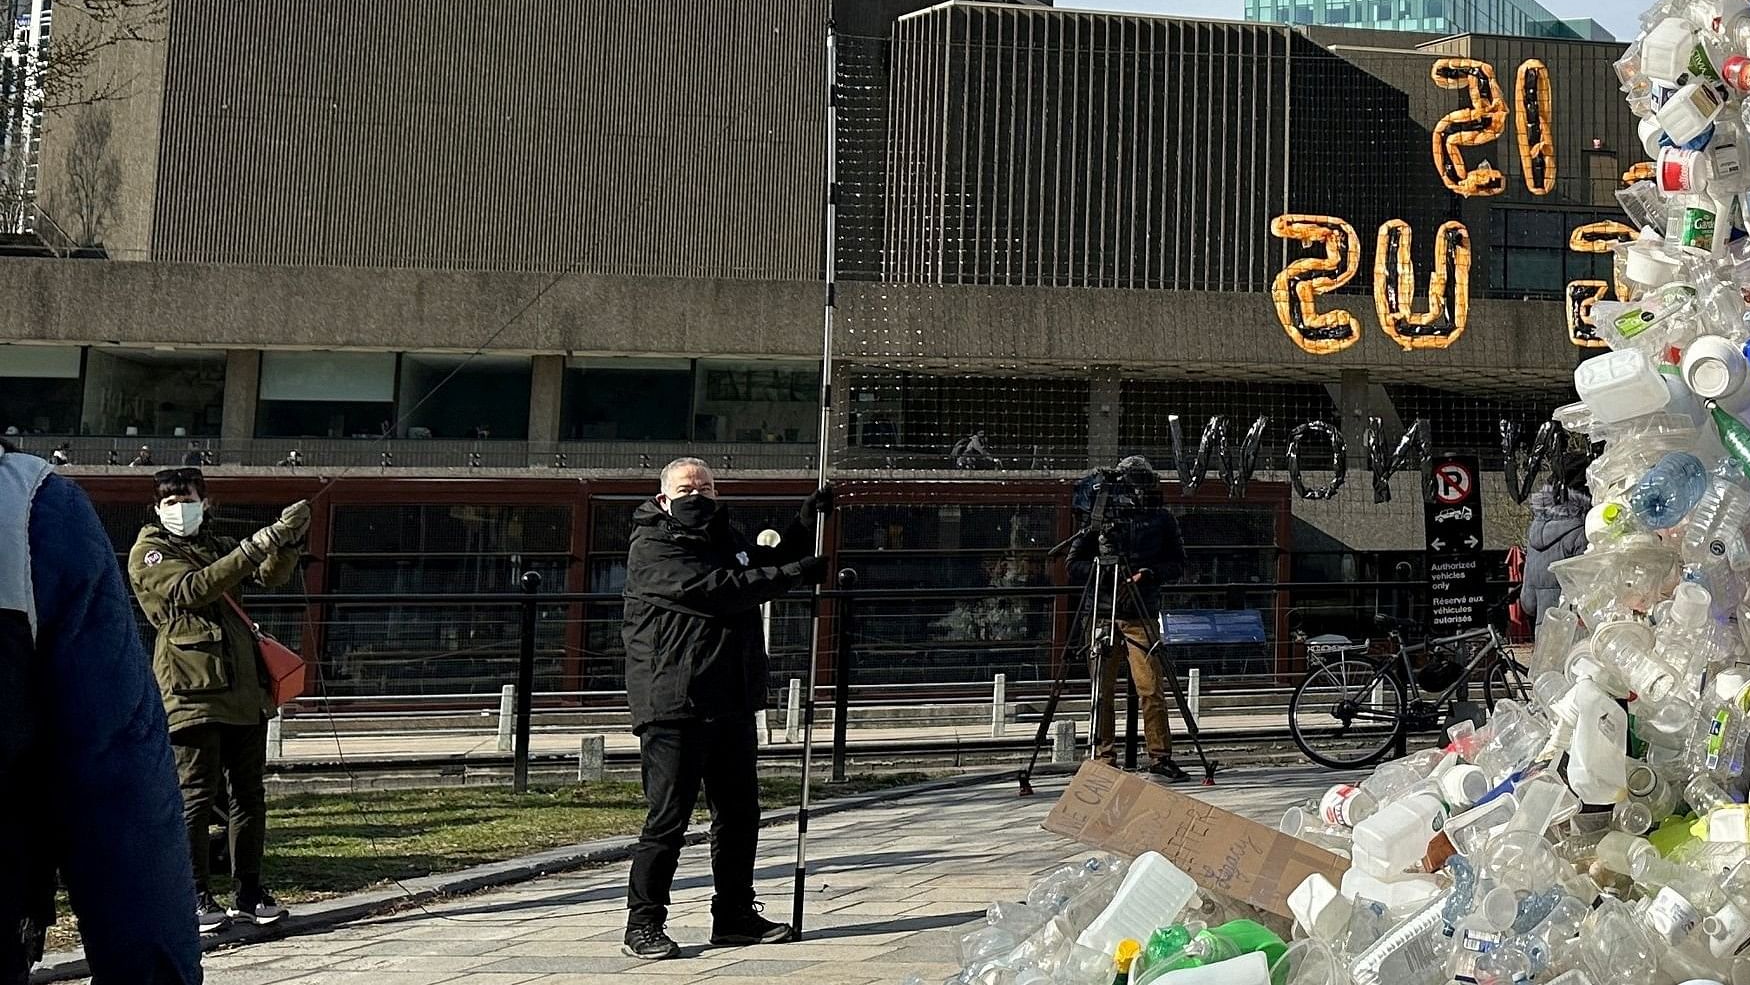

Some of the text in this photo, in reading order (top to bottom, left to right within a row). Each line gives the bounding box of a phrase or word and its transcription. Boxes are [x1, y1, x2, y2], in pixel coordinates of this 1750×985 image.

[1431, 560, 1477, 572] Authorized
[1431, 571, 1466, 581] vehicles
[1431, 582, 1450, 591] only
[1468, 595, 1485, 603] aux
